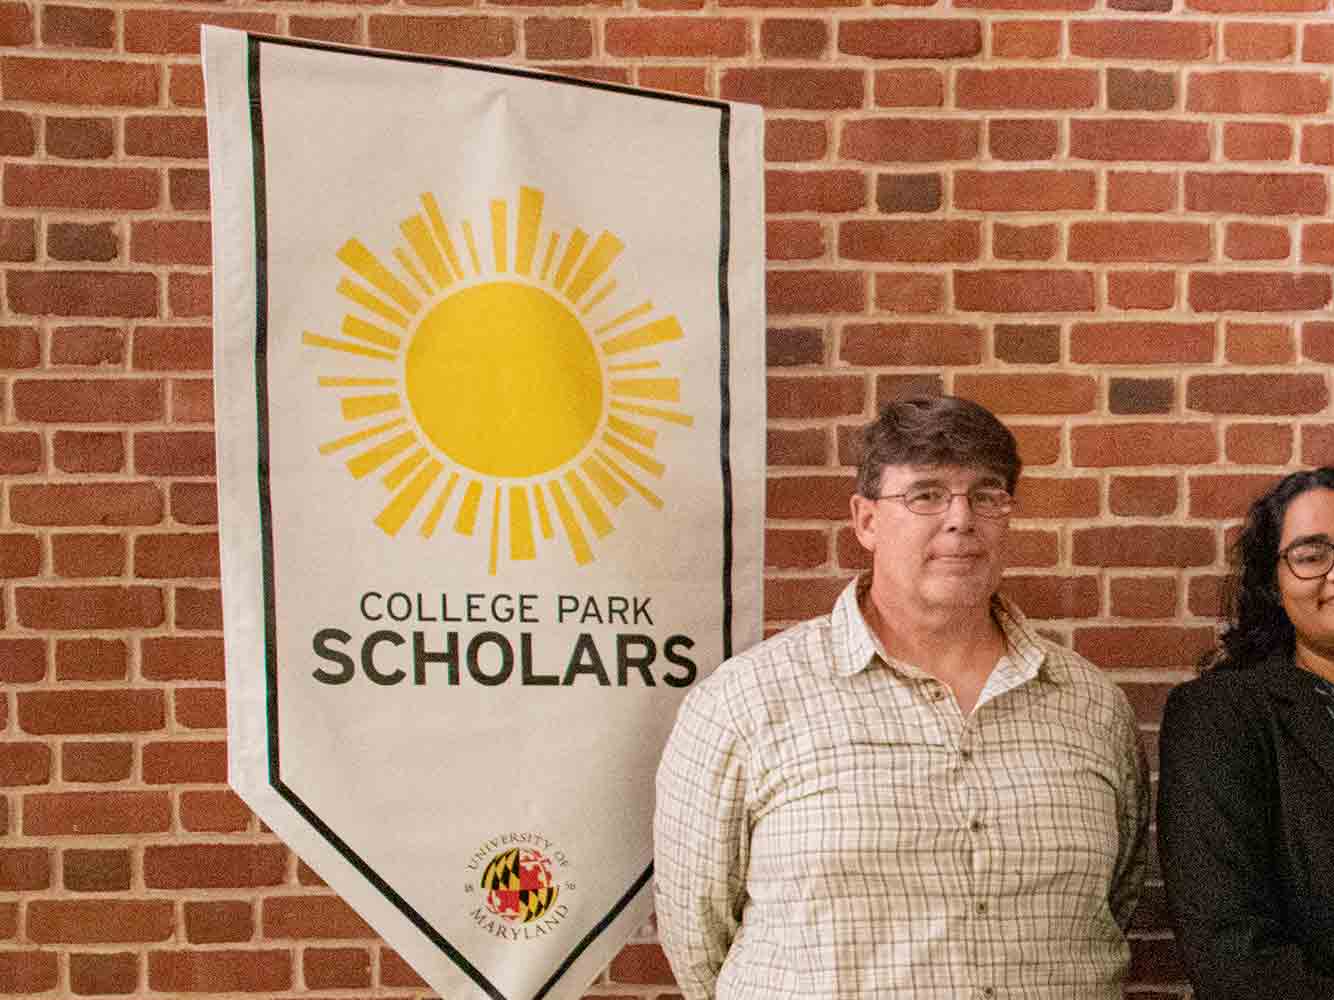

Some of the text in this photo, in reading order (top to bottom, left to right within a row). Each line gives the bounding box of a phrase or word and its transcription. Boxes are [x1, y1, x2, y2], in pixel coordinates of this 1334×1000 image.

[360, 592, 655, 624] COLLEGE PARK
[312, 628, 698, 687] SCHOLARS
[465, 832, 569, 873] UNIVERSITY OF
[470, 904, 569, 940] MARYLAND
